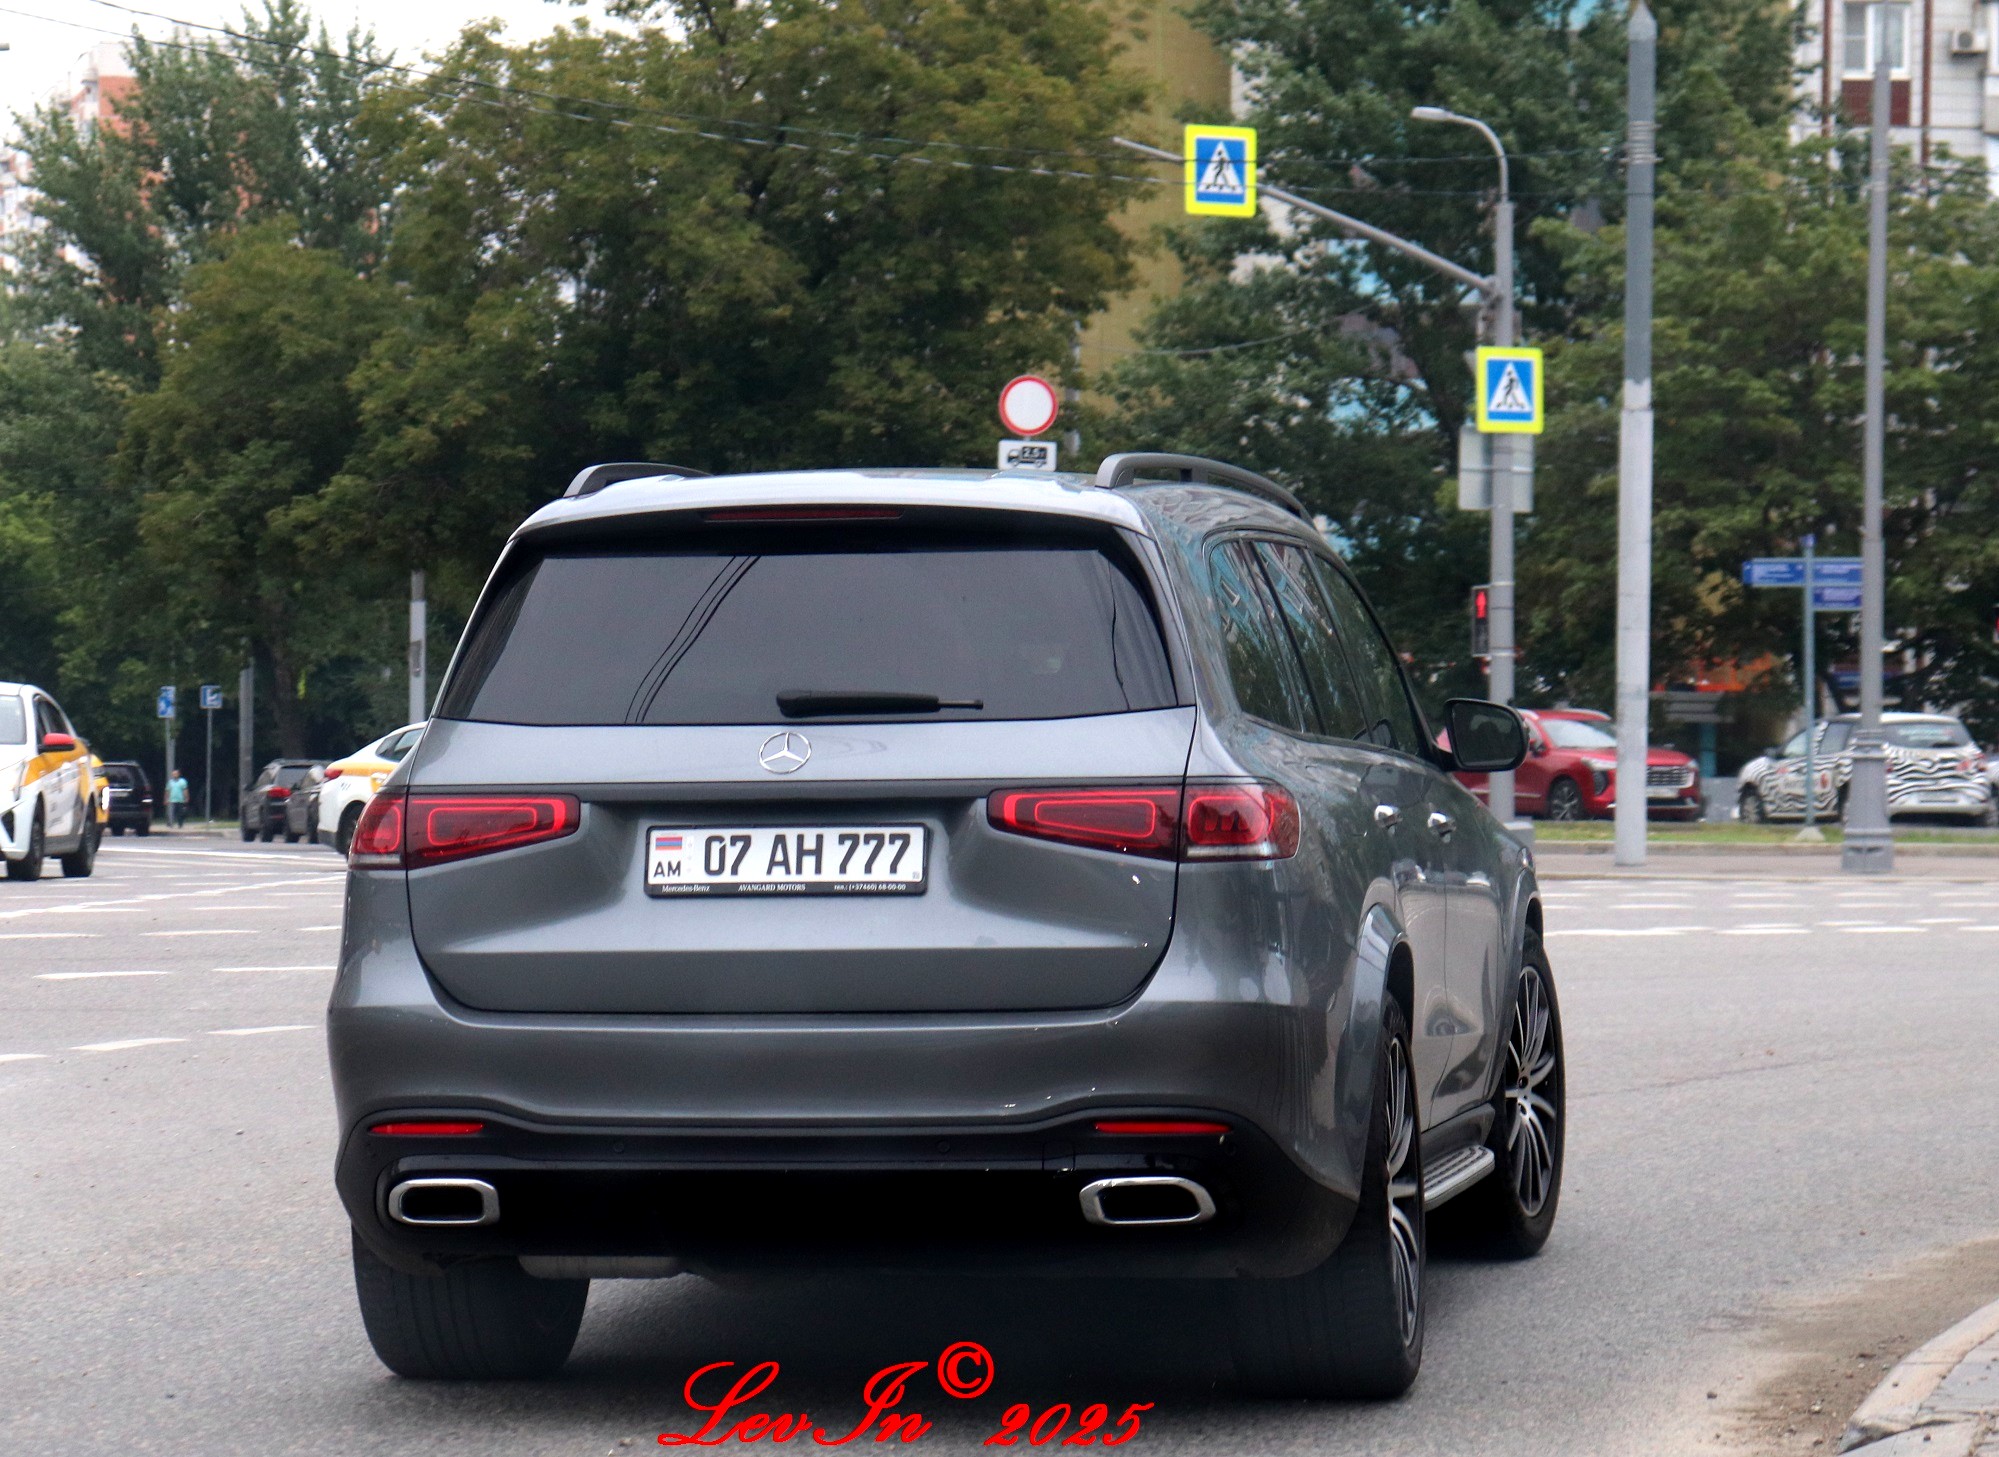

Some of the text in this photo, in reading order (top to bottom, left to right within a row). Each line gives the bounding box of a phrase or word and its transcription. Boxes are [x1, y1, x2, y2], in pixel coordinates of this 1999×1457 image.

[704, 832, 911, 876] 07 AH 777
[653, 860, 681, 877] AM
[662, 885, 710, 893] Mercedes-Benz
[738, 883, 806, 892] AVANGARD MOTORS
